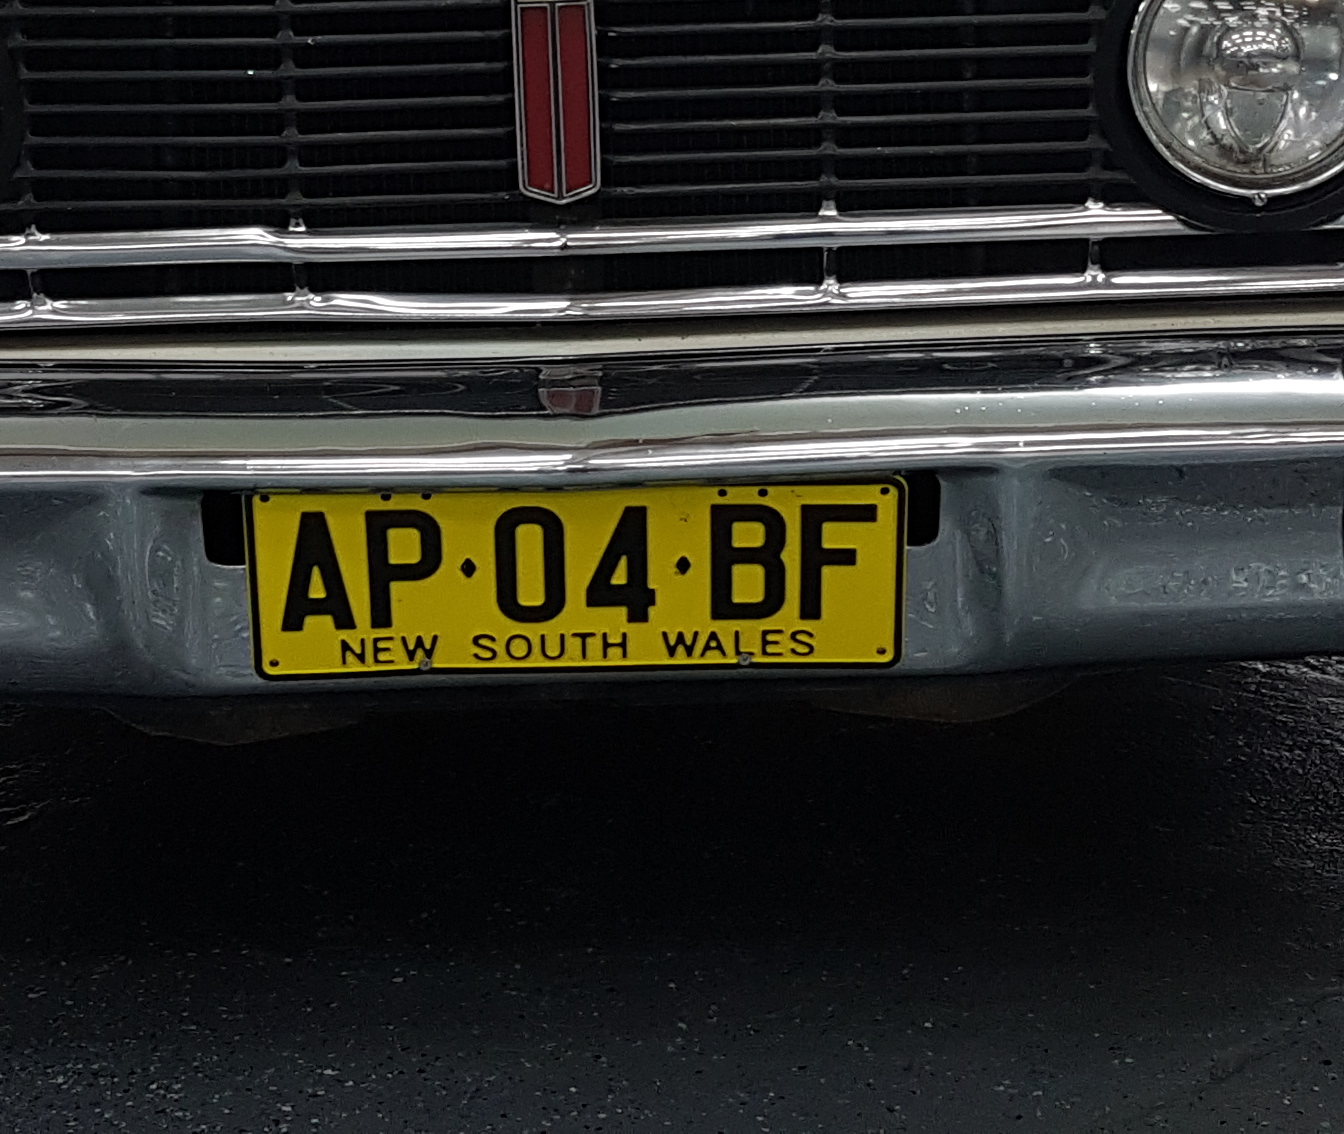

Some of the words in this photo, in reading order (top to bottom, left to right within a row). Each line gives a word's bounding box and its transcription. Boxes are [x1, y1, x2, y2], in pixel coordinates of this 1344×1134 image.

[341, 635, 438, 666] NEW
[472, 632, 629, 661] SOUTH
[662, 628, 816, 659] WALES
